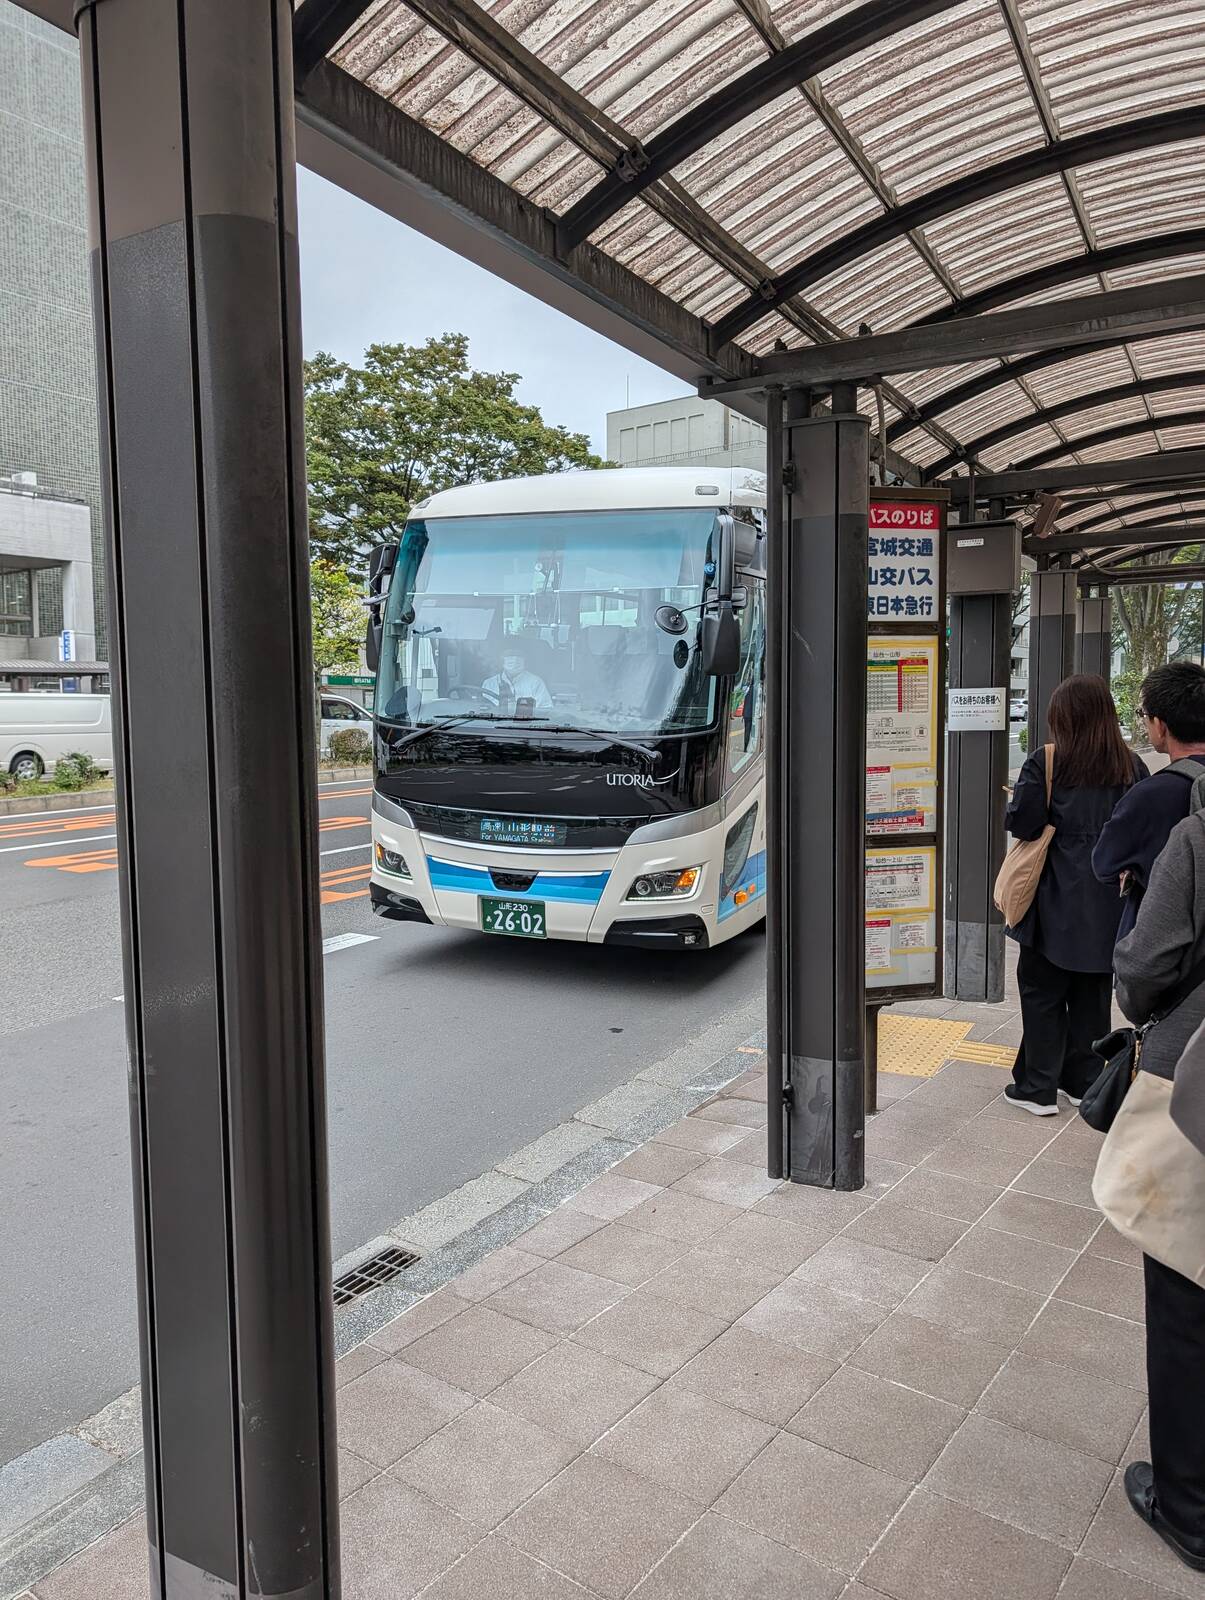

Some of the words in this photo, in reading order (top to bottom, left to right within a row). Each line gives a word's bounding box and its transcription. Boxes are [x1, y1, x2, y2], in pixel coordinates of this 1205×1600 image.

[606, 773, 655, 788] UTORIA
[481, 832, 492, 841] For
[493, 833, 529, 843] YAMAGATA
